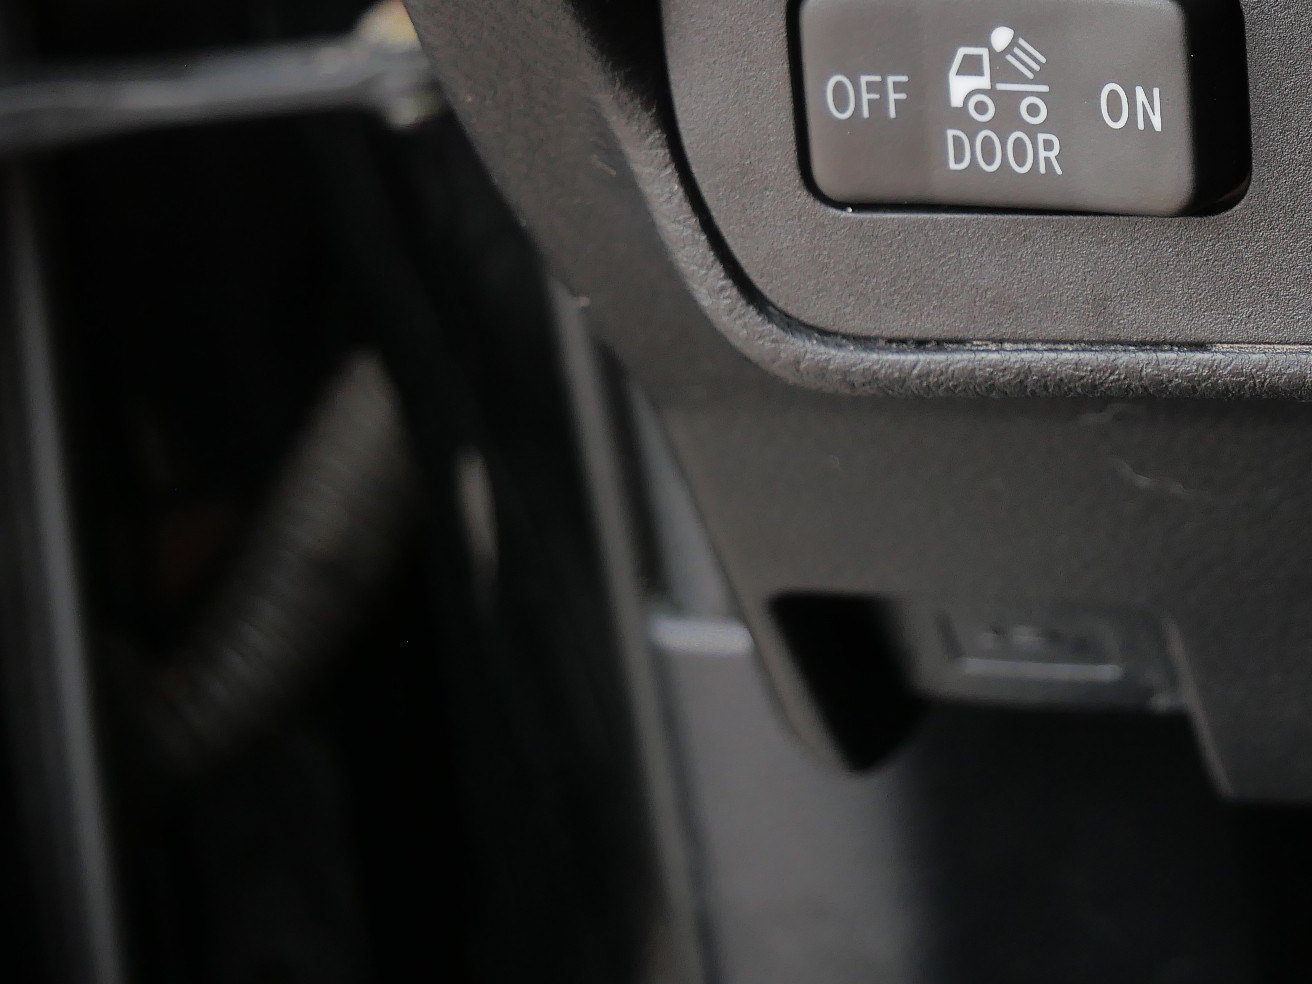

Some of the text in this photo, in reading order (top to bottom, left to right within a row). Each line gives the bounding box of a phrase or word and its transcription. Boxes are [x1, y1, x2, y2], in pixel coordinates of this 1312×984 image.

[825, 73, 909, 121] OFF
[1099, 81, 1163, 133] ON
[945, 127, 1064, 176] DOOR
